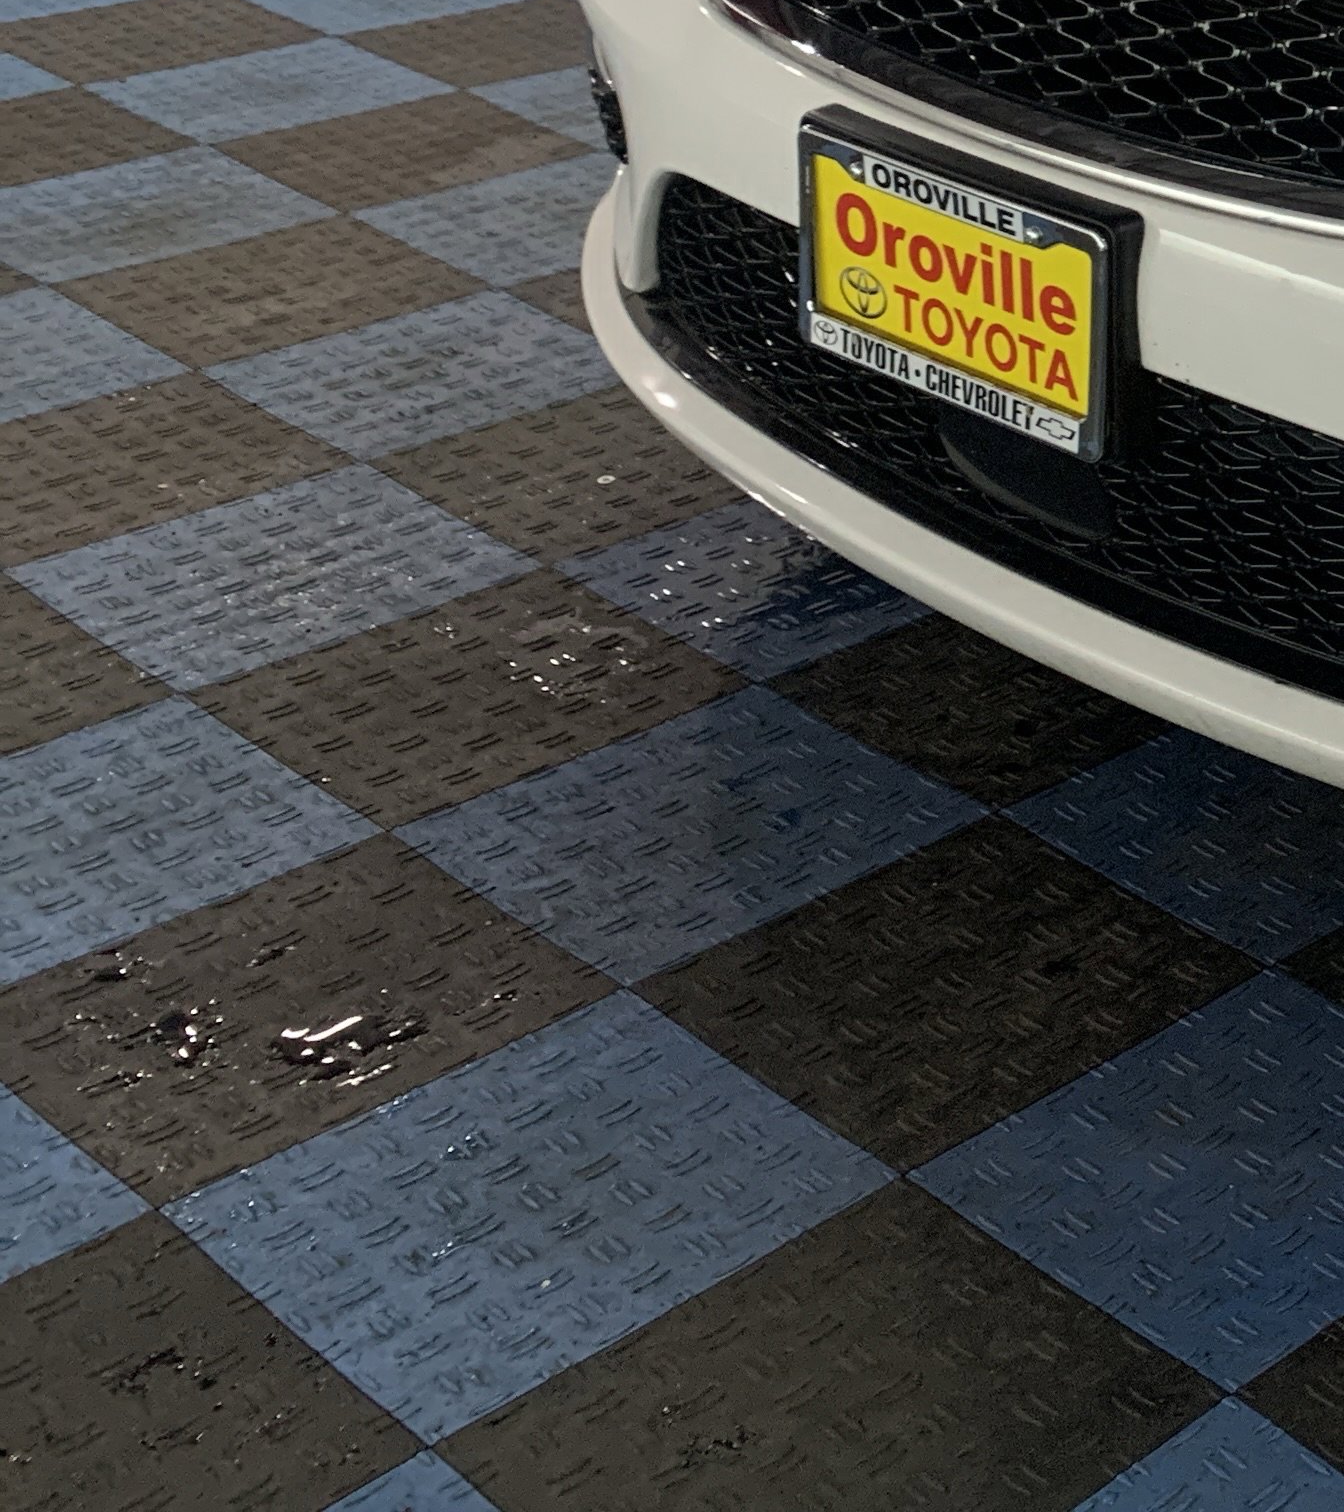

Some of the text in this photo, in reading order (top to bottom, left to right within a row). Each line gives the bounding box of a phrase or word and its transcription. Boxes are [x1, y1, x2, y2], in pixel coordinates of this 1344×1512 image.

[871, 164, 1016, 237] OROVILLE
[835, 193, 1076, 336] Oroville
[840, 328, 1035, 431] TOYOTA CHEVROLET
[894, 285, 1079, 402] TOYOTA
